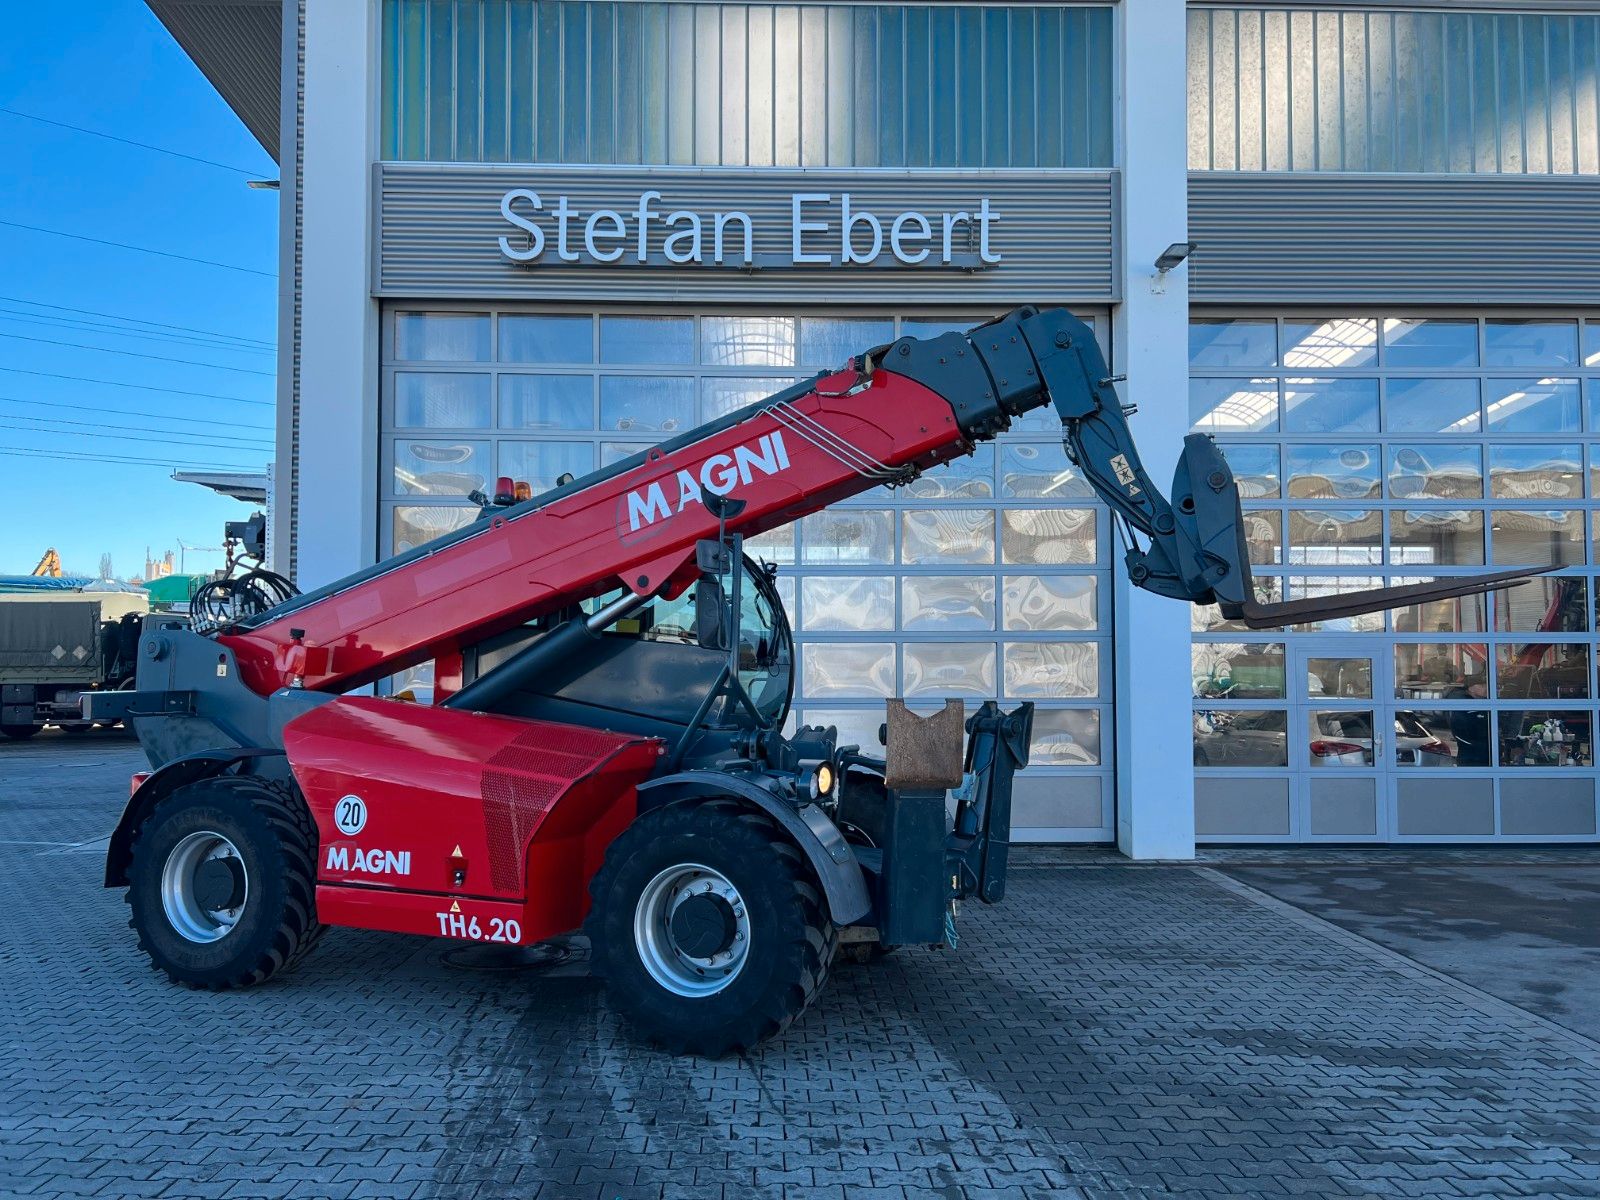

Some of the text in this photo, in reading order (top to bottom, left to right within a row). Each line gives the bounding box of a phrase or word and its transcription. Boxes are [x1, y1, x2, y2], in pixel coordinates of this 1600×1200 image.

[498, 188, 1001, 265] Stefan Ebert
[627, 430, 791, 532] MAGNI
[341, 801, 361, 827] 20
[326, 847, 411, 875] MAGNI
[436, 912, 521, 944] TH6.20
